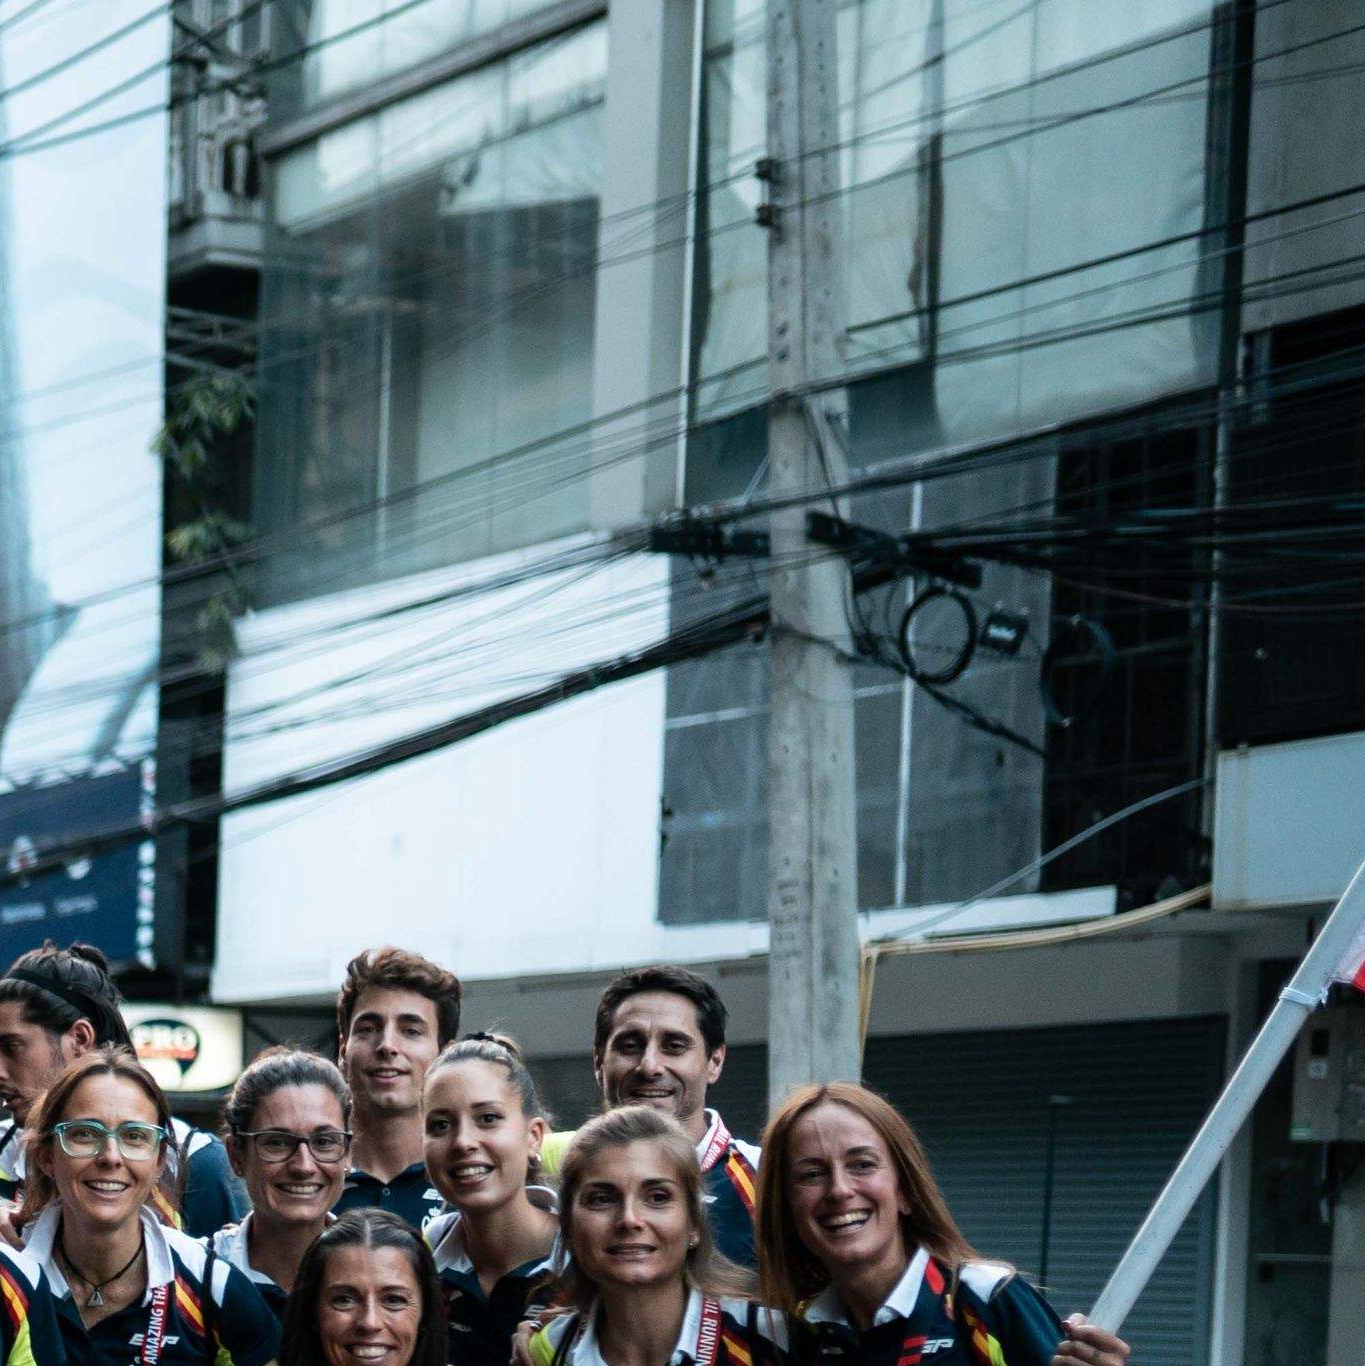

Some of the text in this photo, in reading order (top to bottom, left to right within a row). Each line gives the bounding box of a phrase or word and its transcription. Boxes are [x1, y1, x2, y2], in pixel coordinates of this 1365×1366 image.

[129, 1333, 179, 1348] EP
[144, 1302, 164, 1365] AMAZING
[921, 1339, 955, 1354] SP
